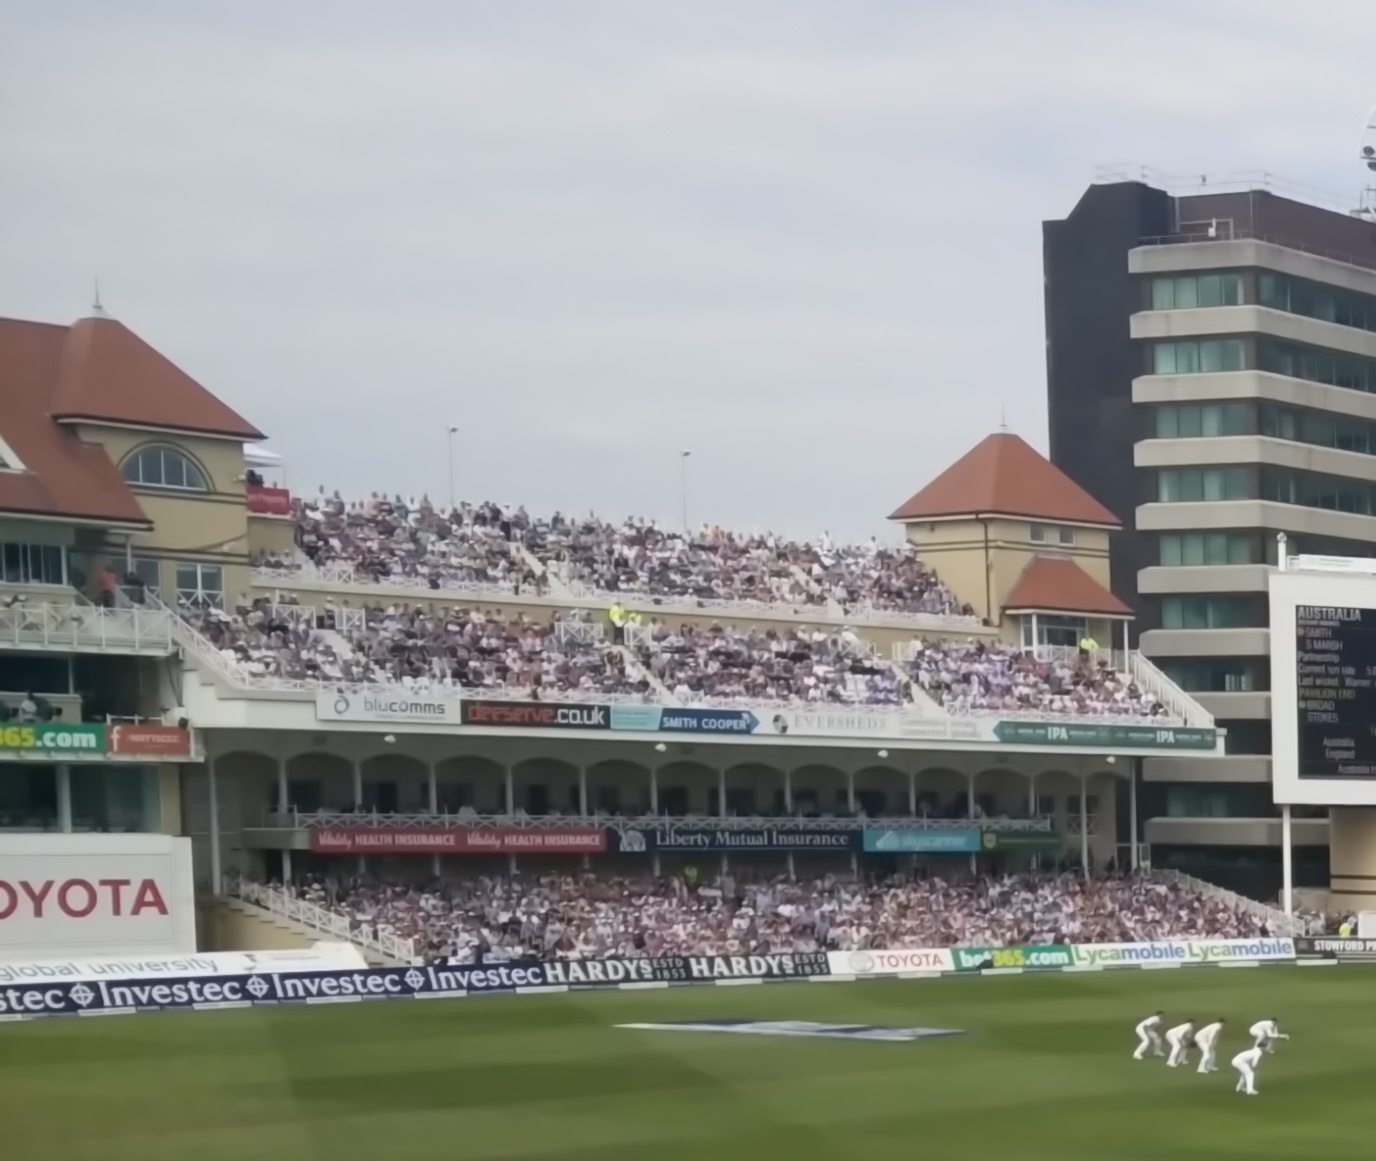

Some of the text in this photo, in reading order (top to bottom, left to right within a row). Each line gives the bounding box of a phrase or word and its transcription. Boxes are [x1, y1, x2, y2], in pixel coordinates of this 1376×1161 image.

[1298, 607, 1362, 621] AUSTRALIA
[364, 698, 445, 715] blucomms
[663, 717, 697, 728] SMITH
[702, 718, 746, 729] COOPER
[795, 714, 886, 730] EVERSHEDS
[0, 727, 97, 748] 65.com
[1048, 727, 1068, 740] IPA
[1156, 731, 1175, 743] IPA
[355, 834, 392, 845] HEALTH
[395, 834, 455, 845] INSURANCE
[504, 834, 542, 845] HEALTH
[544, 834, 600, 845] INSURANCE
[656, 830, 849, 850] Liberty Mutual Insurance
[1187, 940, 1293, 960] Lycamobile
[1314, 940, 1364, 951] STOWFORD
[653, 957, 684, 968] ESTD
[795, 952, 827, 964] ESTD
[877, 953, 944, 969] TOYOTA
[1075, 946, 1186, 964] Lycamobile
[90, 955, 219, 975] university
[798, 963, 828, 975] 1853
[427, 965, 543, 991] Investec
[656, 968, 687, 980] 1853
[272, 972, 402, 998] Investec
[98, 979, 243, 1008] Investec
